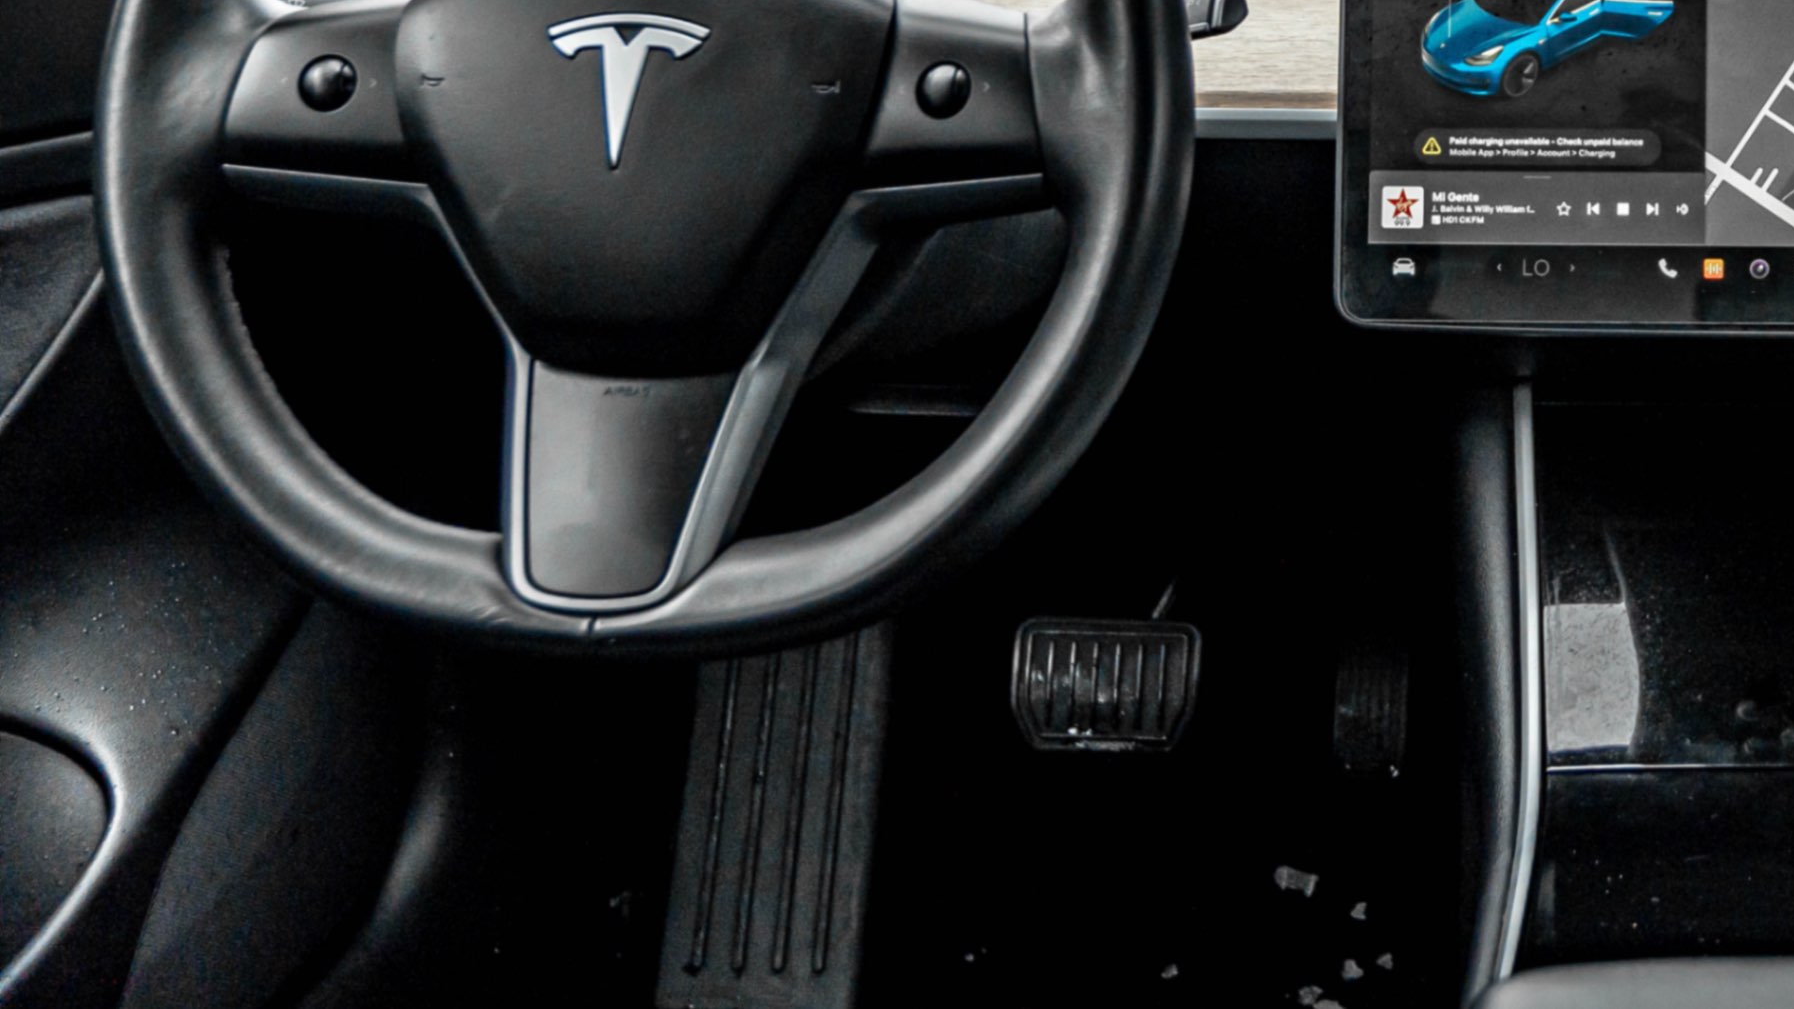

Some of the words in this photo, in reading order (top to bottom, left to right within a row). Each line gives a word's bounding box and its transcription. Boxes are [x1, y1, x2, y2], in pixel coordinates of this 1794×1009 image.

[1449, 136, 1468, 145] Paid
[1468, 137, 1504, 147] charging
[1504, 136, 1550, 146] unavailable
[1556, 137, 1582, 146] Check
[1583, 138, 1611, 148] unpaid
[1612, 137, 1644, 146] balance
[1449, 148, 1476, 156] Mobile
[1478, 148, 1495, 158] App
[1502, 148, 1529, 156] Profile
[1537, 149, 1571, 157] Account
[1578, 149, 1616, 159] Charging
[1432, 191, 1446, 203] Mi
[1447, 191, 1480, 203] Gente
[1440, 204, 1465, 213] Balvin
[1522, 258, 1551, 277] LO
